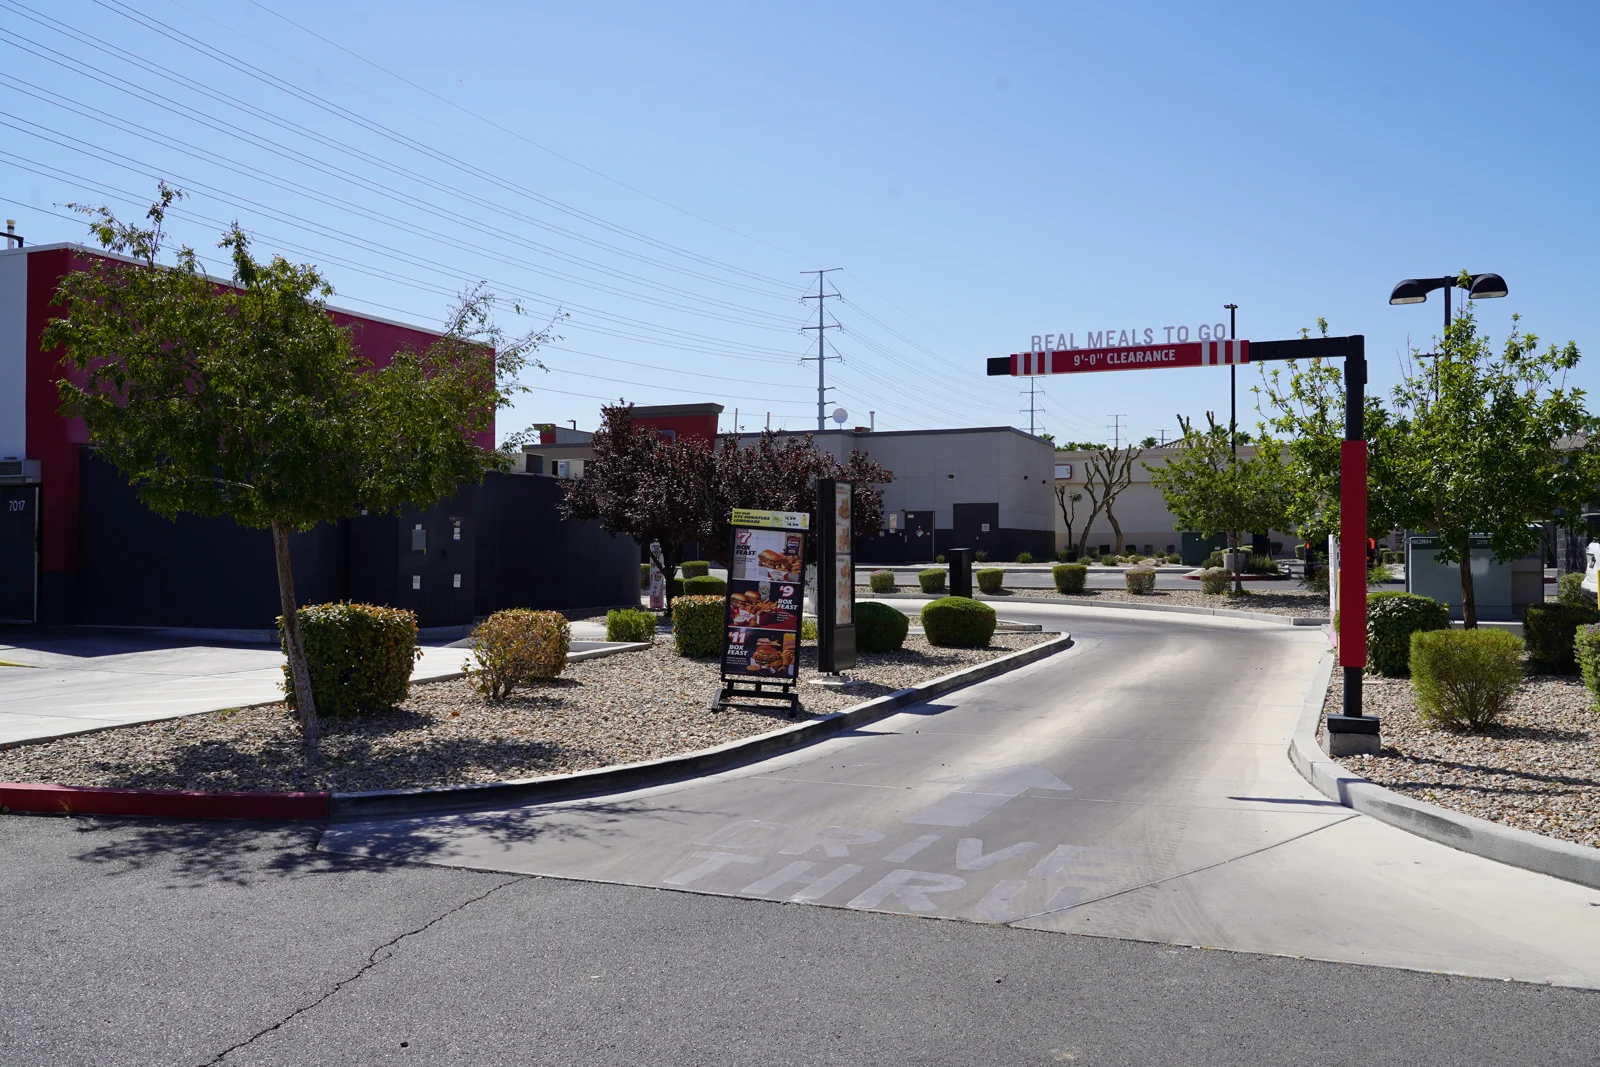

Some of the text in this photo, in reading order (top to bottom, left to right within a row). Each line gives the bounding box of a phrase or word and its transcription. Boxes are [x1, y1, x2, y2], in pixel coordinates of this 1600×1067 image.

[1031, 323, 1226, 353] REAL MEALS TO GO
[1107, 349, 1176, 364] CLEARANCE
[8, 500, 25, 512] 7017
[737, 532, 752, 544] $7
[779, 585, 795, 598] $9
[728, 631, 748, 645] $11
[692, 822, 1136, 883] DRIVE
[662, 850, 1088, 922] THRU
